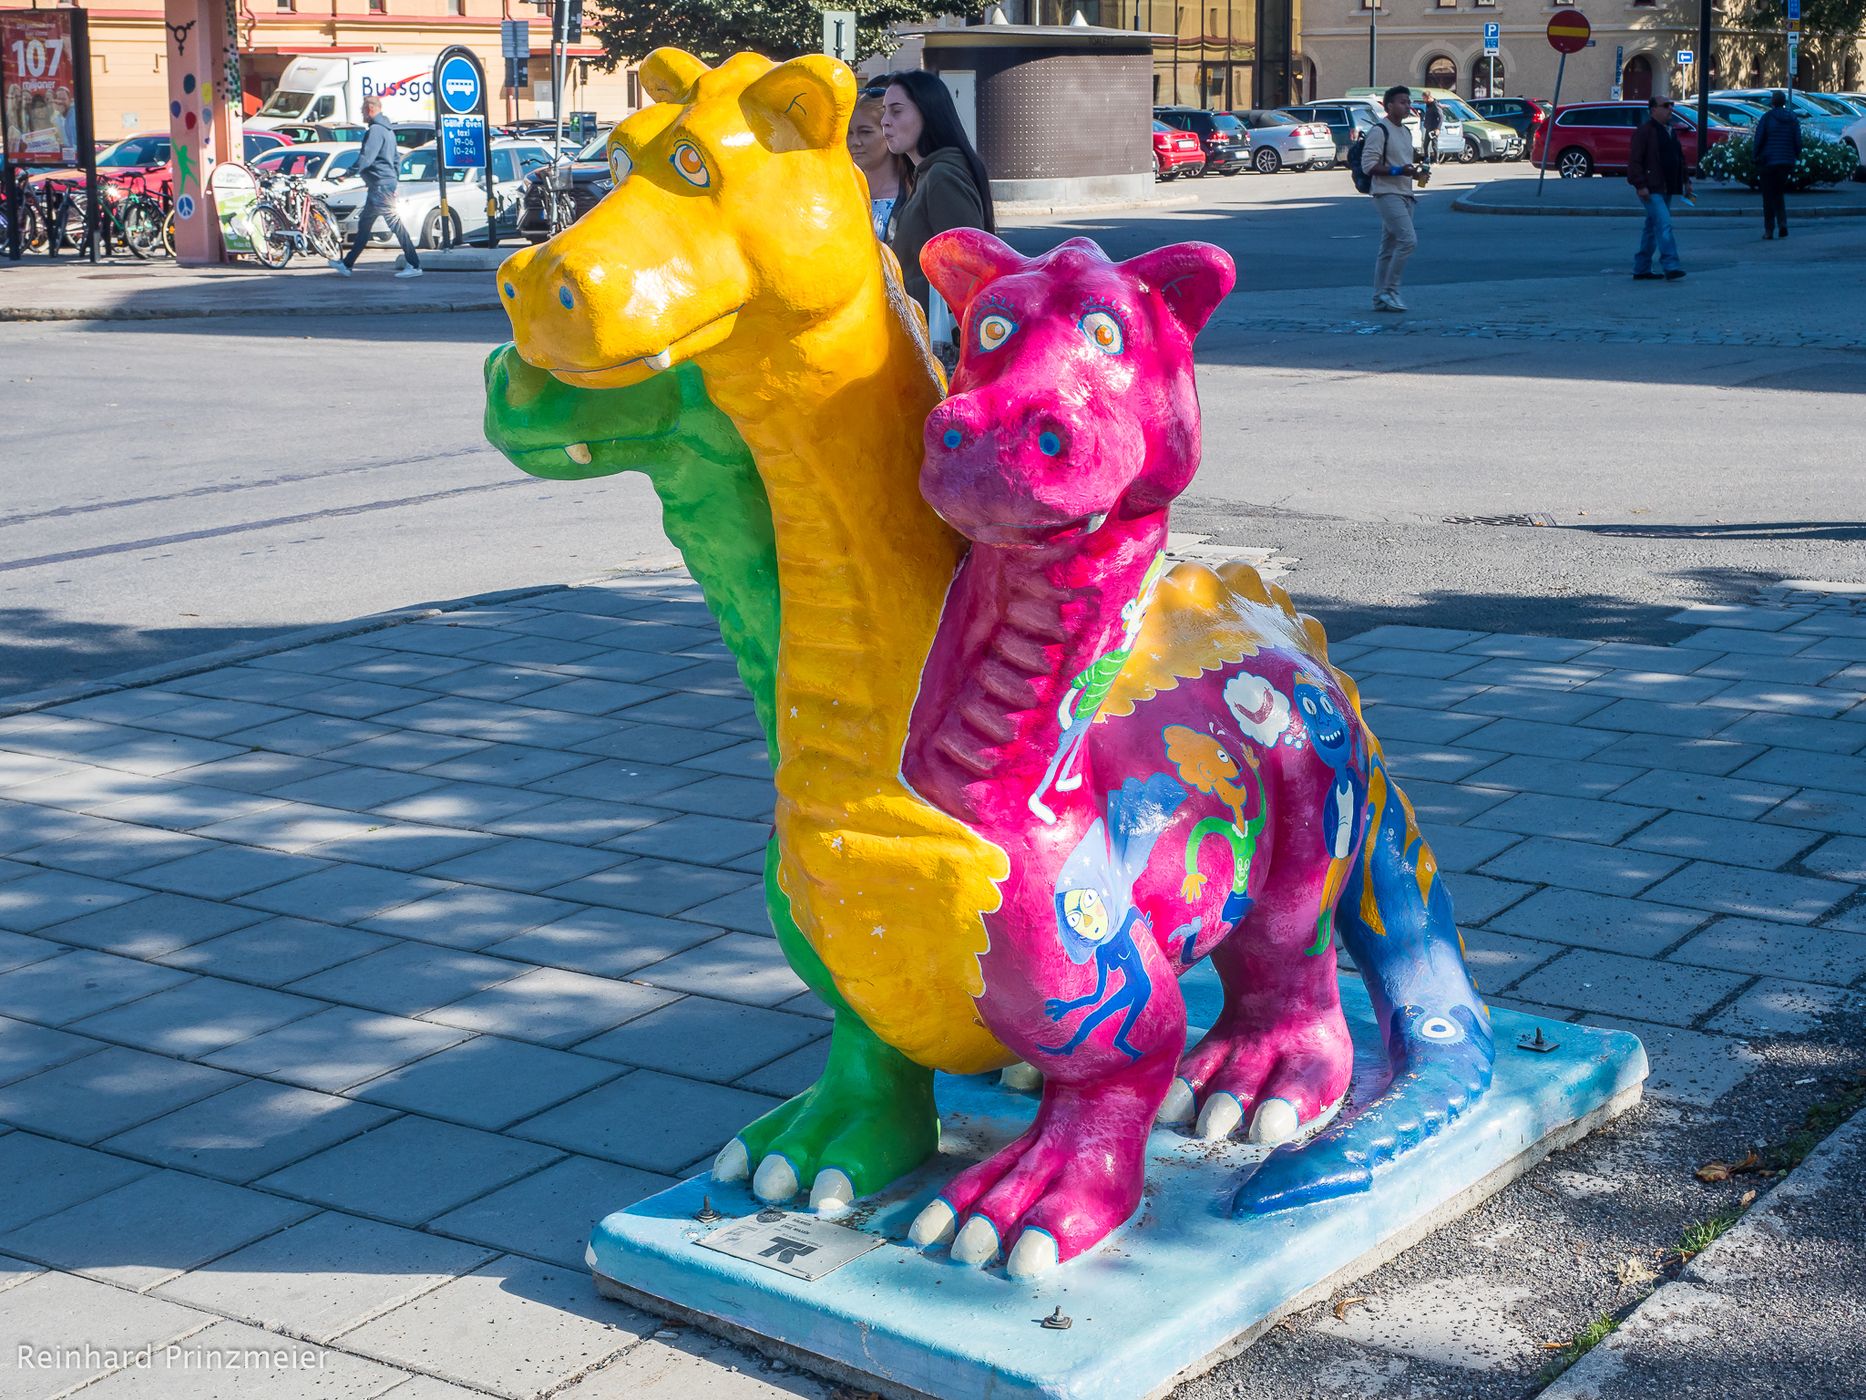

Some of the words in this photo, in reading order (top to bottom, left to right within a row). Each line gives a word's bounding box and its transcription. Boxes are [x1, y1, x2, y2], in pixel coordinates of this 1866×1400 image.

[1488, 25, 1497, 36] P
[12, 39, 65, 77] 107
[457, 129, 470, 137] taxi
[454, 138, 474, 146] 19-06
